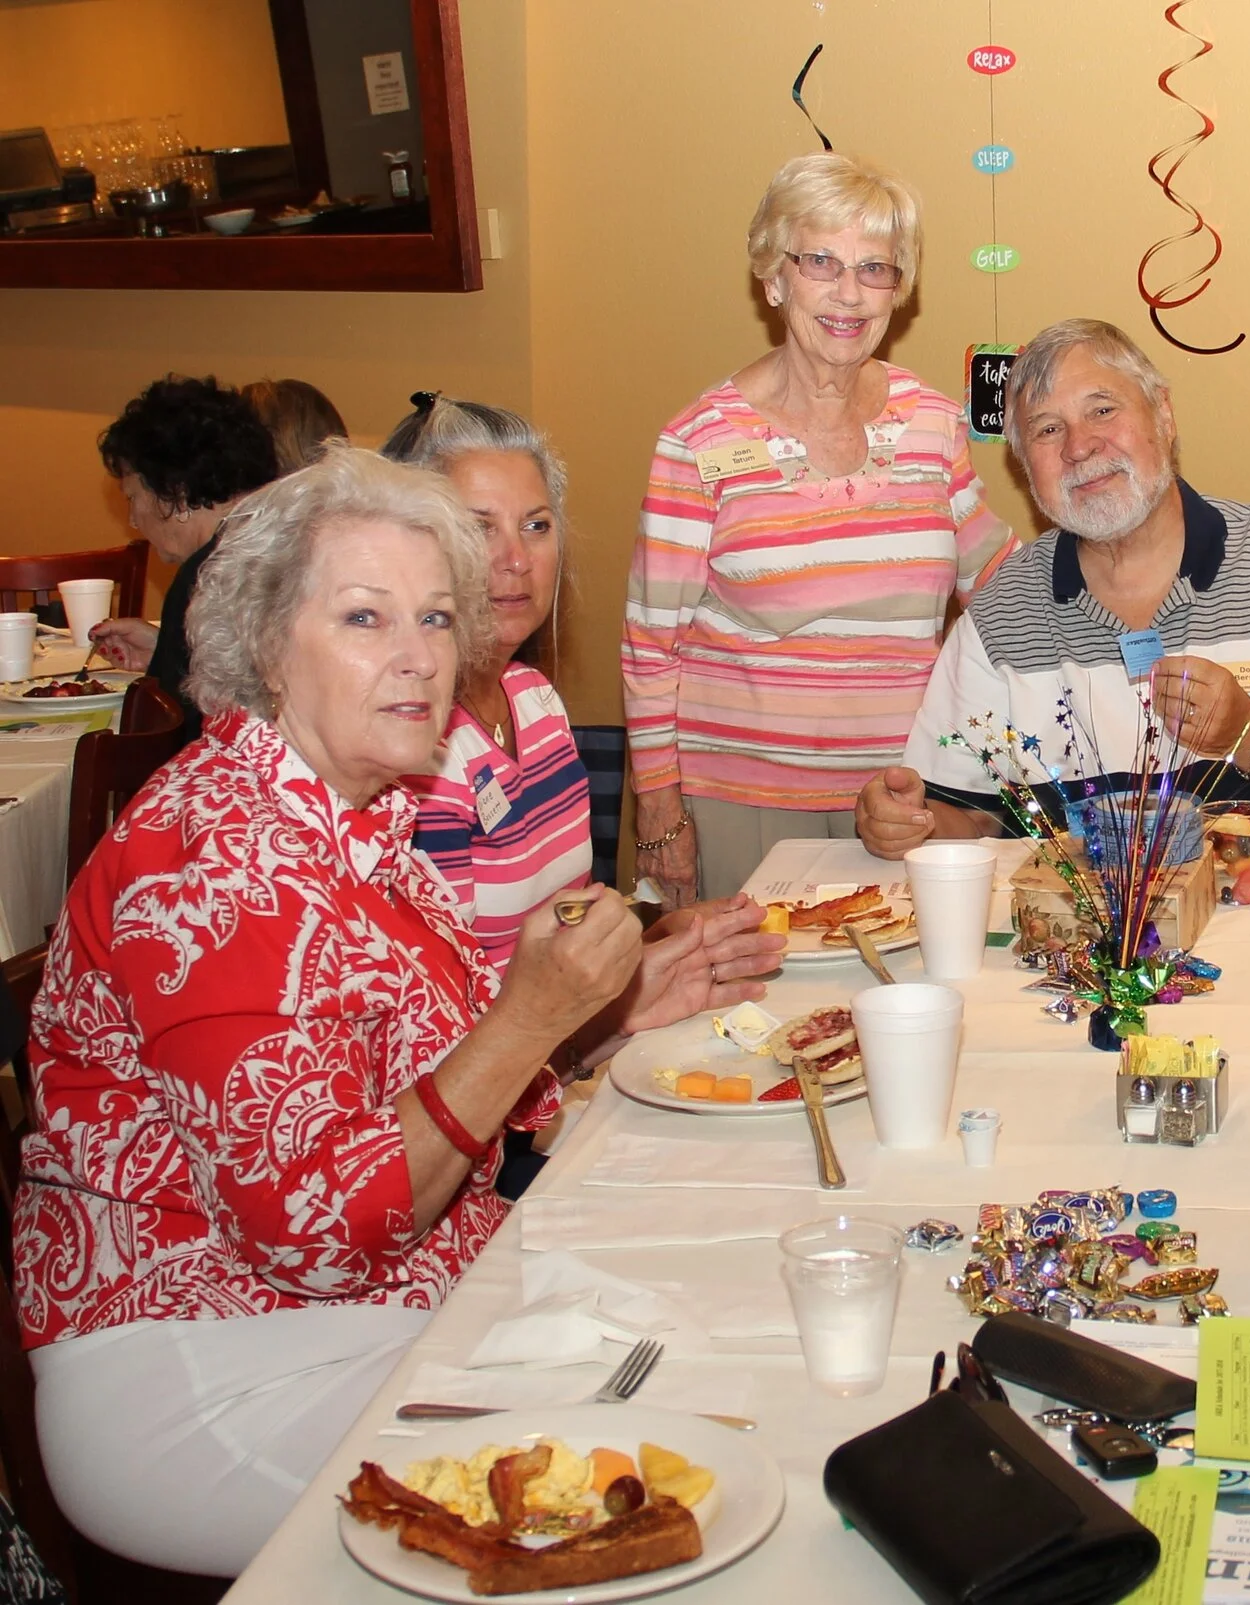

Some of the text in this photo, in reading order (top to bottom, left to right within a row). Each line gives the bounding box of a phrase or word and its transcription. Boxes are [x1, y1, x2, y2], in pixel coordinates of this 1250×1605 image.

[978, 151, 1009, 168] SLEEP
[976, 250, 1013, 267] GOLF
[994, 390, 1004, 409] it
[981, 411, 1004, 427] eas
[732, 448, 751, 457] Joan
[732, 456, 755, 464] Tatum
[1034, 1216, 1066, 1239] York
